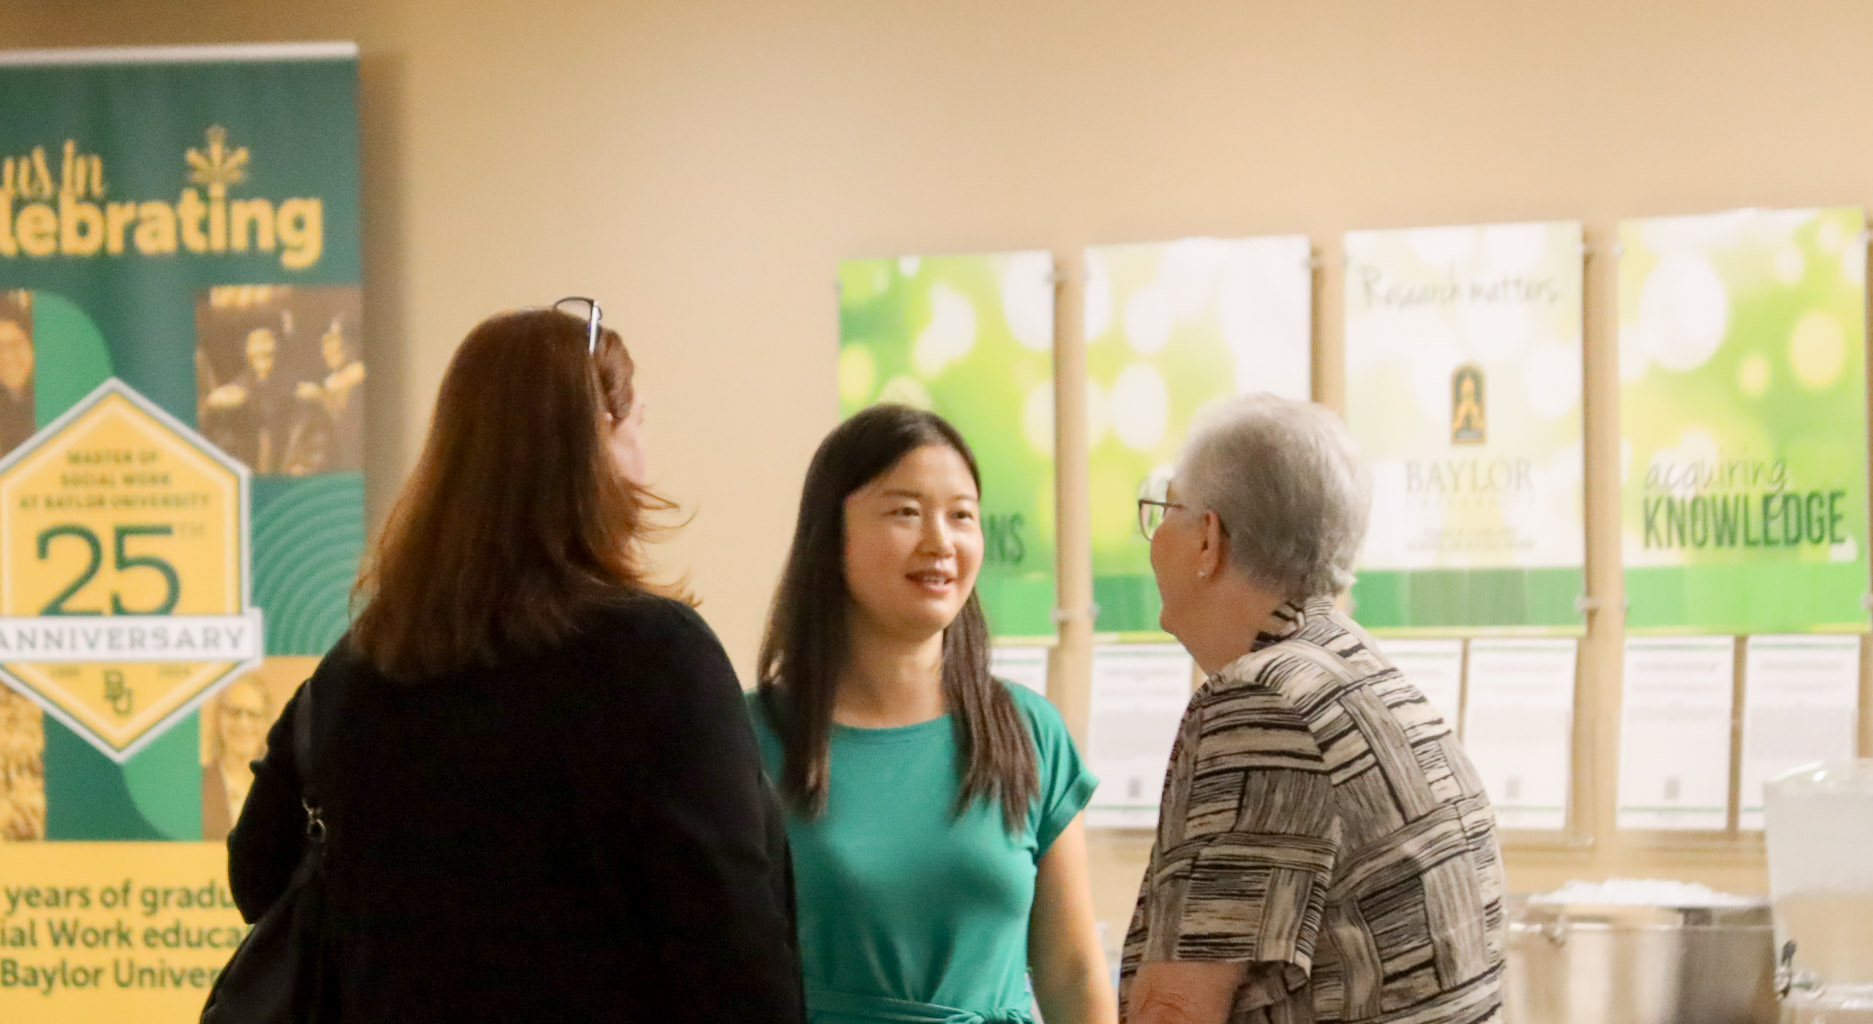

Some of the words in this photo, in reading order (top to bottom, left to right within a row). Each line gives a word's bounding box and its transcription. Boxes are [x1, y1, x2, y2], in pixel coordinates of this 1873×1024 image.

[1405, 457, 1535, 494] BAYLOR
[1644, 448, 1787, 517] acquiring
[983, 512, 1026, 565] NS
[1643, 489, 1846, 549] KNOWLEDGE
[5, 885, 91, 917] years
[100, 878, 132, 908] of
[48, 918, 133, 948] Work
[143, 918, 249, 949] educa
[0, 958, 104, 996] Baylor
